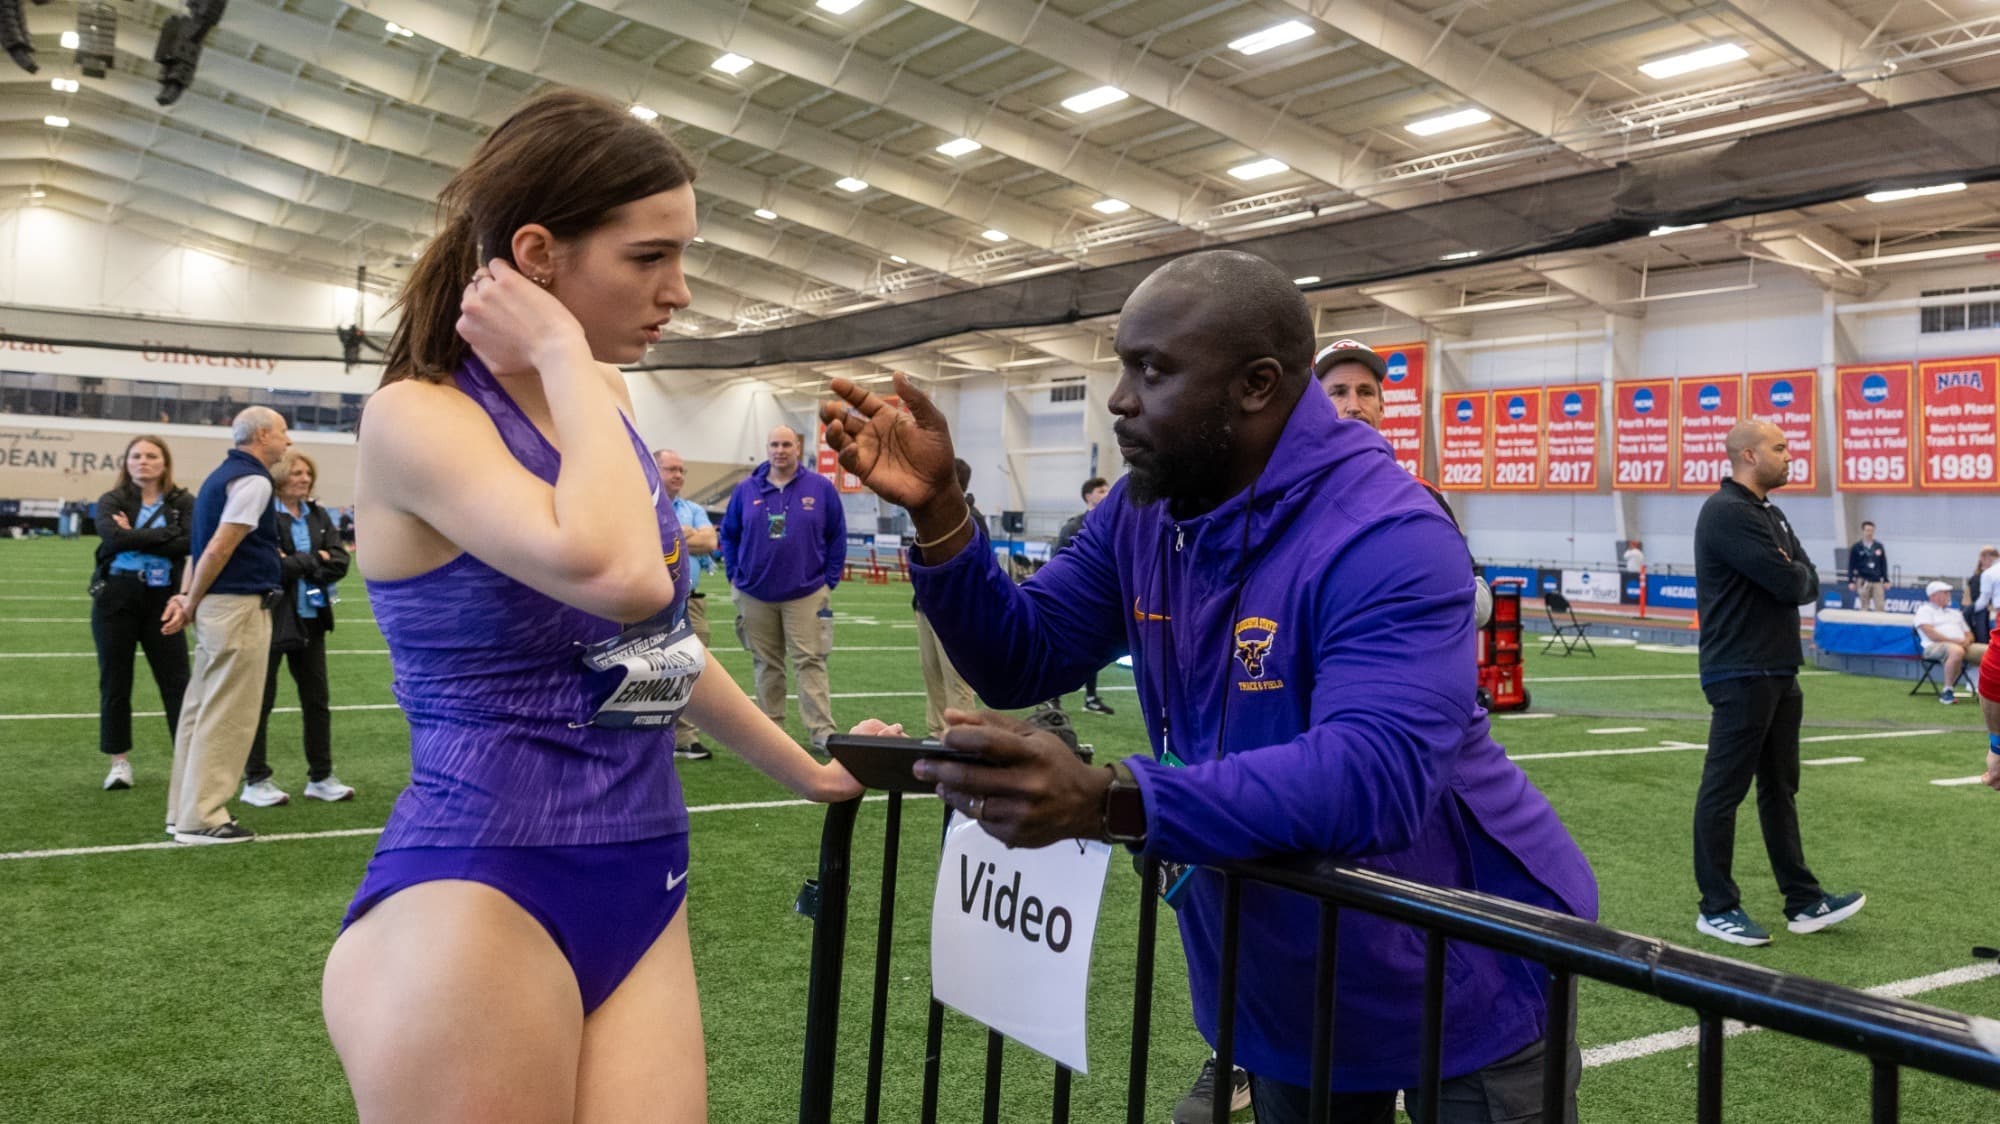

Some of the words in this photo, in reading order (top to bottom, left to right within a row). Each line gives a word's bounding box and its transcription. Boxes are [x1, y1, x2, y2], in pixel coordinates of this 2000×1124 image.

[1935, 371, 1984, 394] NAIA
[1444, 463, 1482, 484] 2022
[1496, 462, 1535, 483] 2021
[1549, 461, 1591, 482] 2017
[1618, 460, 1664, 482] 2017
[1683, 459, 1733, 482] 2016
[1845, 456, 1905, 481] 1995
[1928, 454, 1993, 480] 1989
[961, 853, 1072, 953] Video
